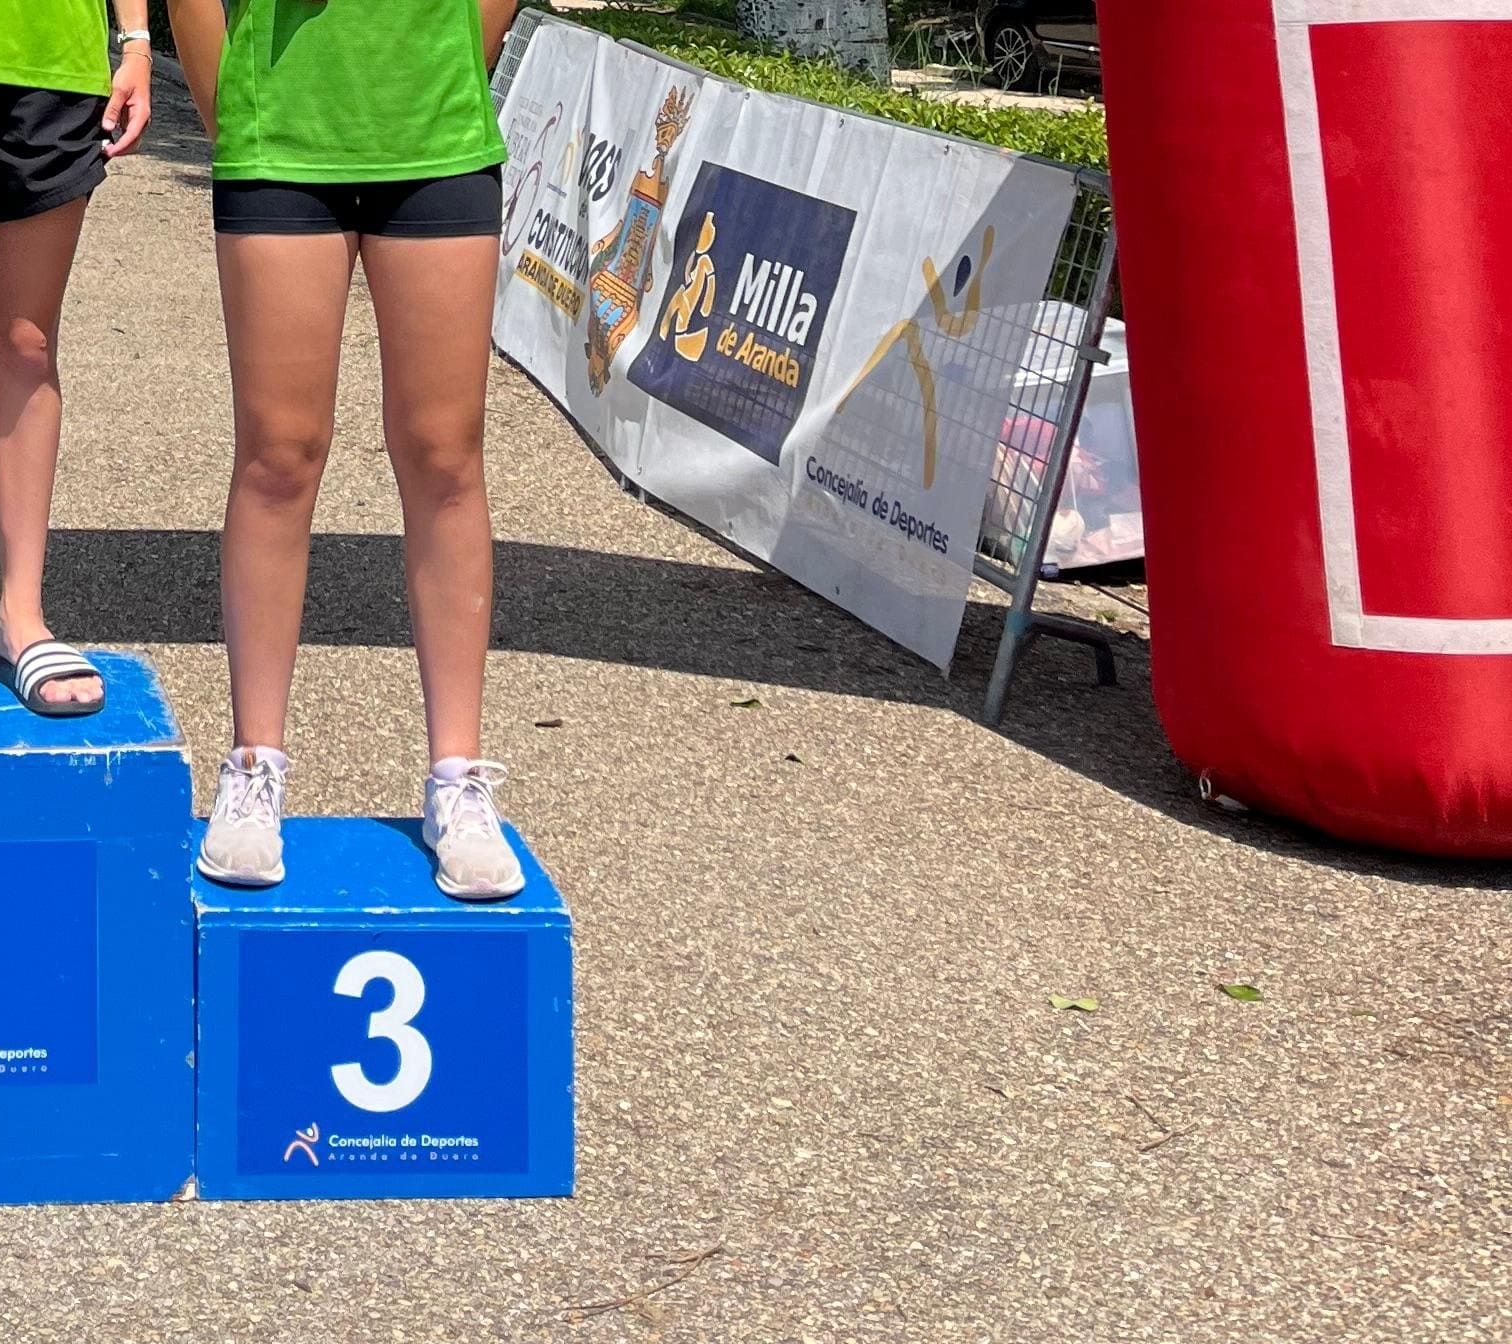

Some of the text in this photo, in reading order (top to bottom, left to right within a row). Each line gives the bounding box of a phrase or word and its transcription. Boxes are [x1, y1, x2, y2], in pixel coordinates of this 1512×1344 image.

[729, 252, 818, 346] Milla
[716, 322, 800, 388] de Aranda
[806, 456, 949, 554] Concejalía de Deportes
[331, 949, 433, 1113] 3
[328, 1151, 479, 1161] Aranda de Duero
[400, 1134, 417, 1147] de
[421, 1134, 479, 1150] Deportes
